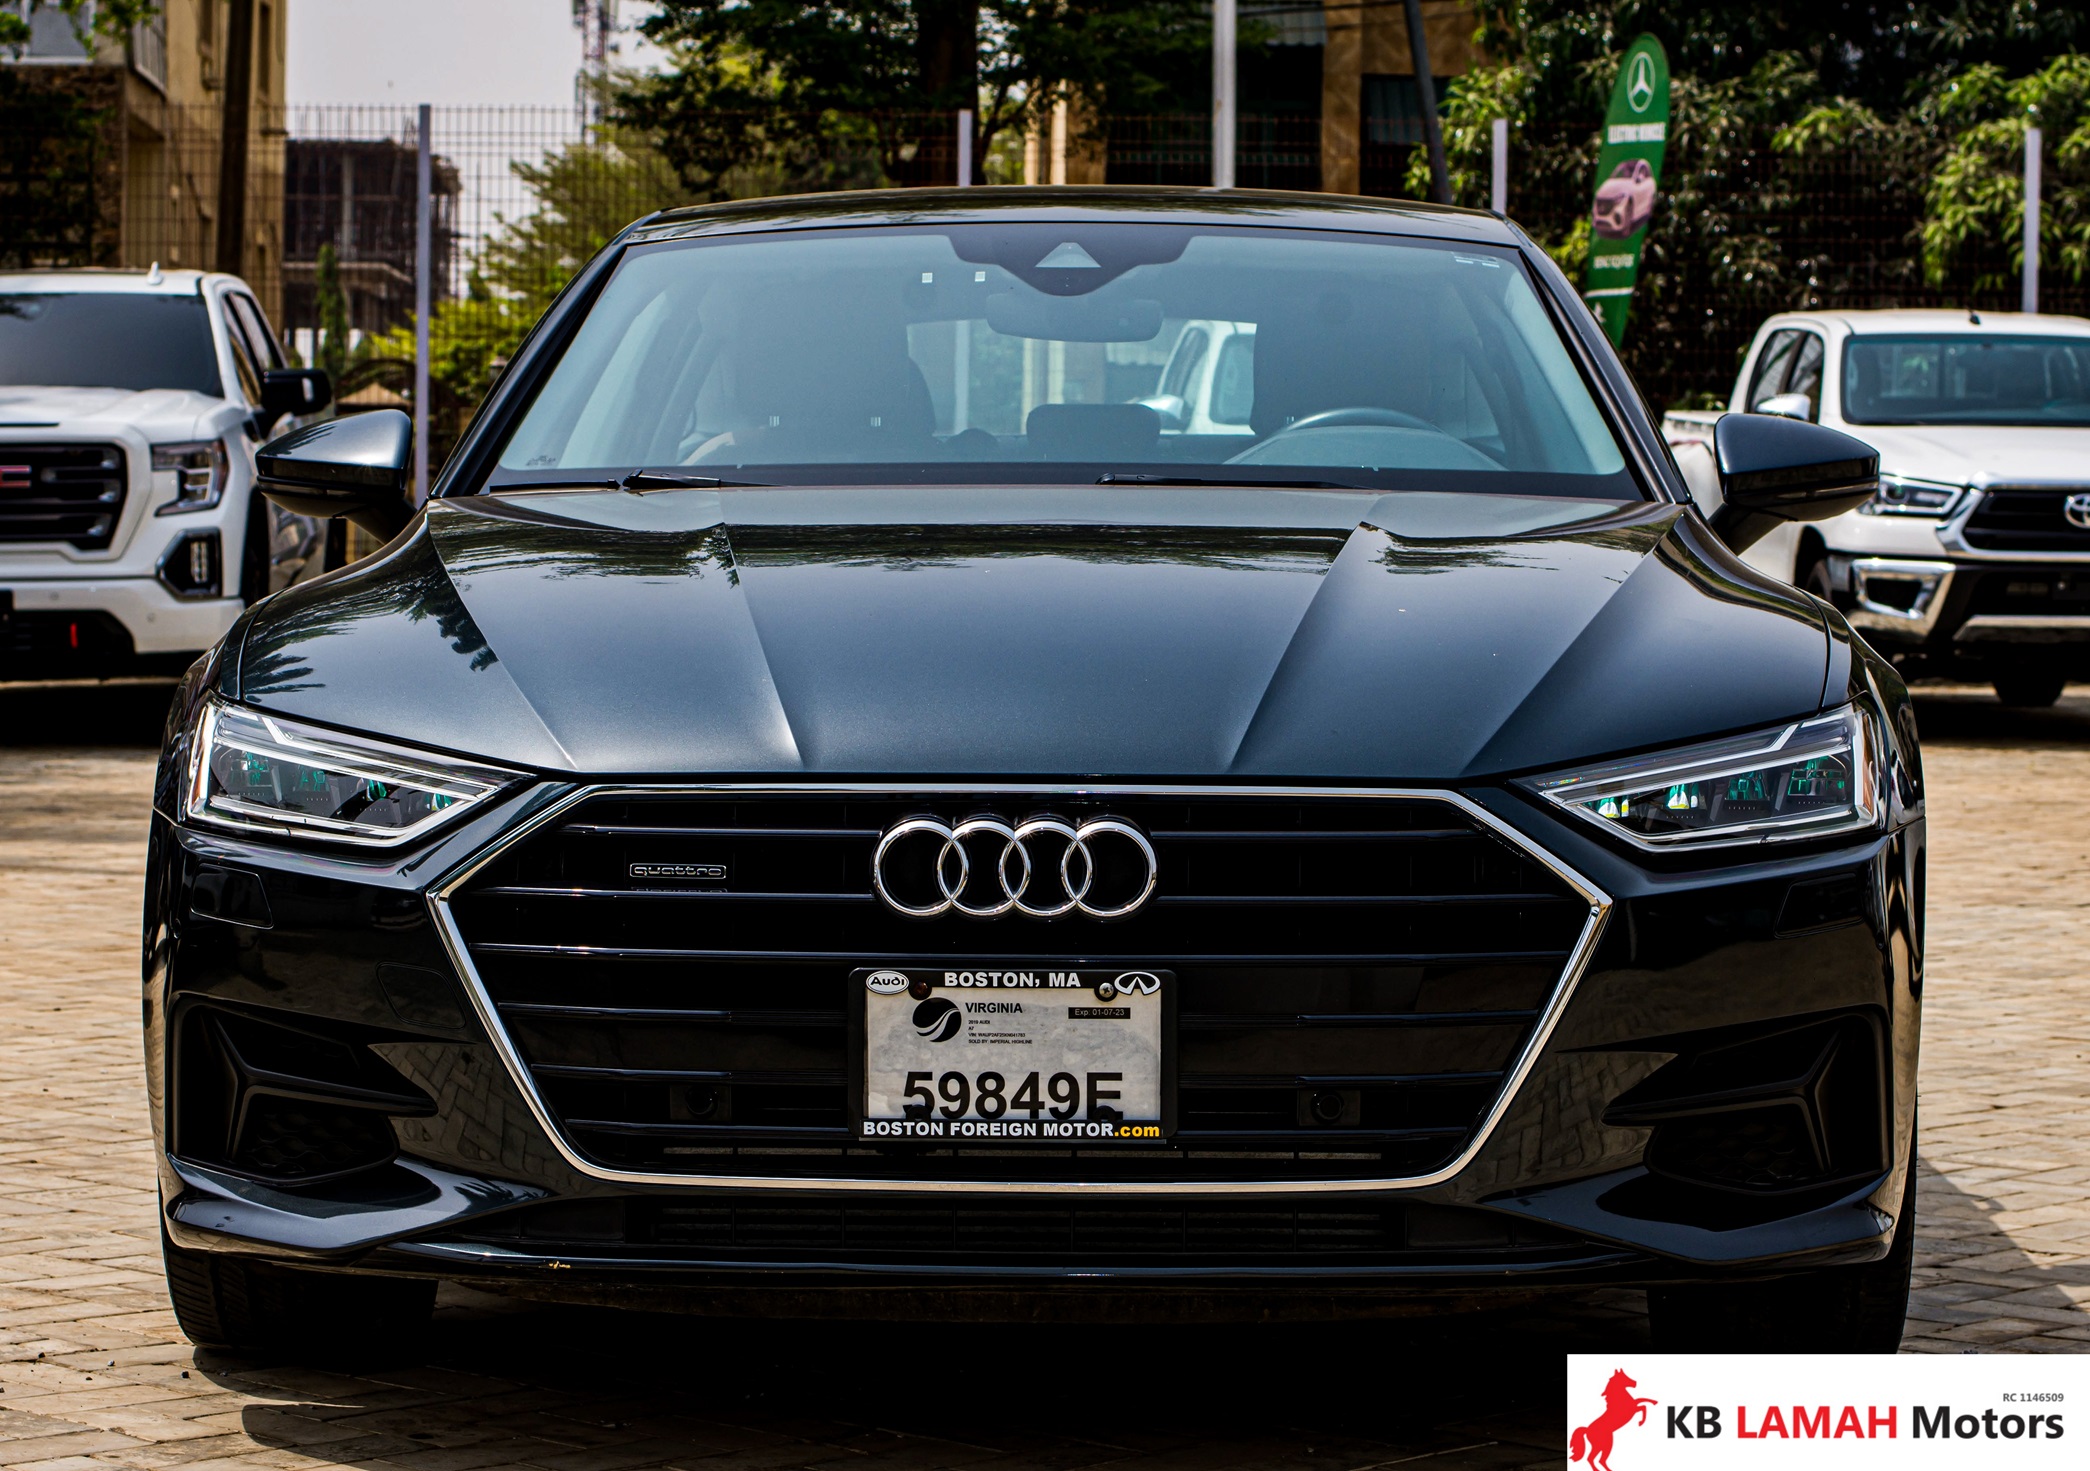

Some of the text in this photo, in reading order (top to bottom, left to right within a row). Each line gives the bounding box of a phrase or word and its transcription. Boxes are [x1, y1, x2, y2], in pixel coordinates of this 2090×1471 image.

[634, 866, 722, 876] quattro
[870, 976, 905, 986] Audi
[944, 972, 1081, 987] BOSTON, MA
[965, 1002, 1023, 1014] VIRGINIA
[1074, 1008, 1125, 1017] Exp: 01-07-23
[902, 1071, 1124, 1120] 59849E
[863, 1121, 1160, 1138] BOSTON FOREIGN MOTOR.com
